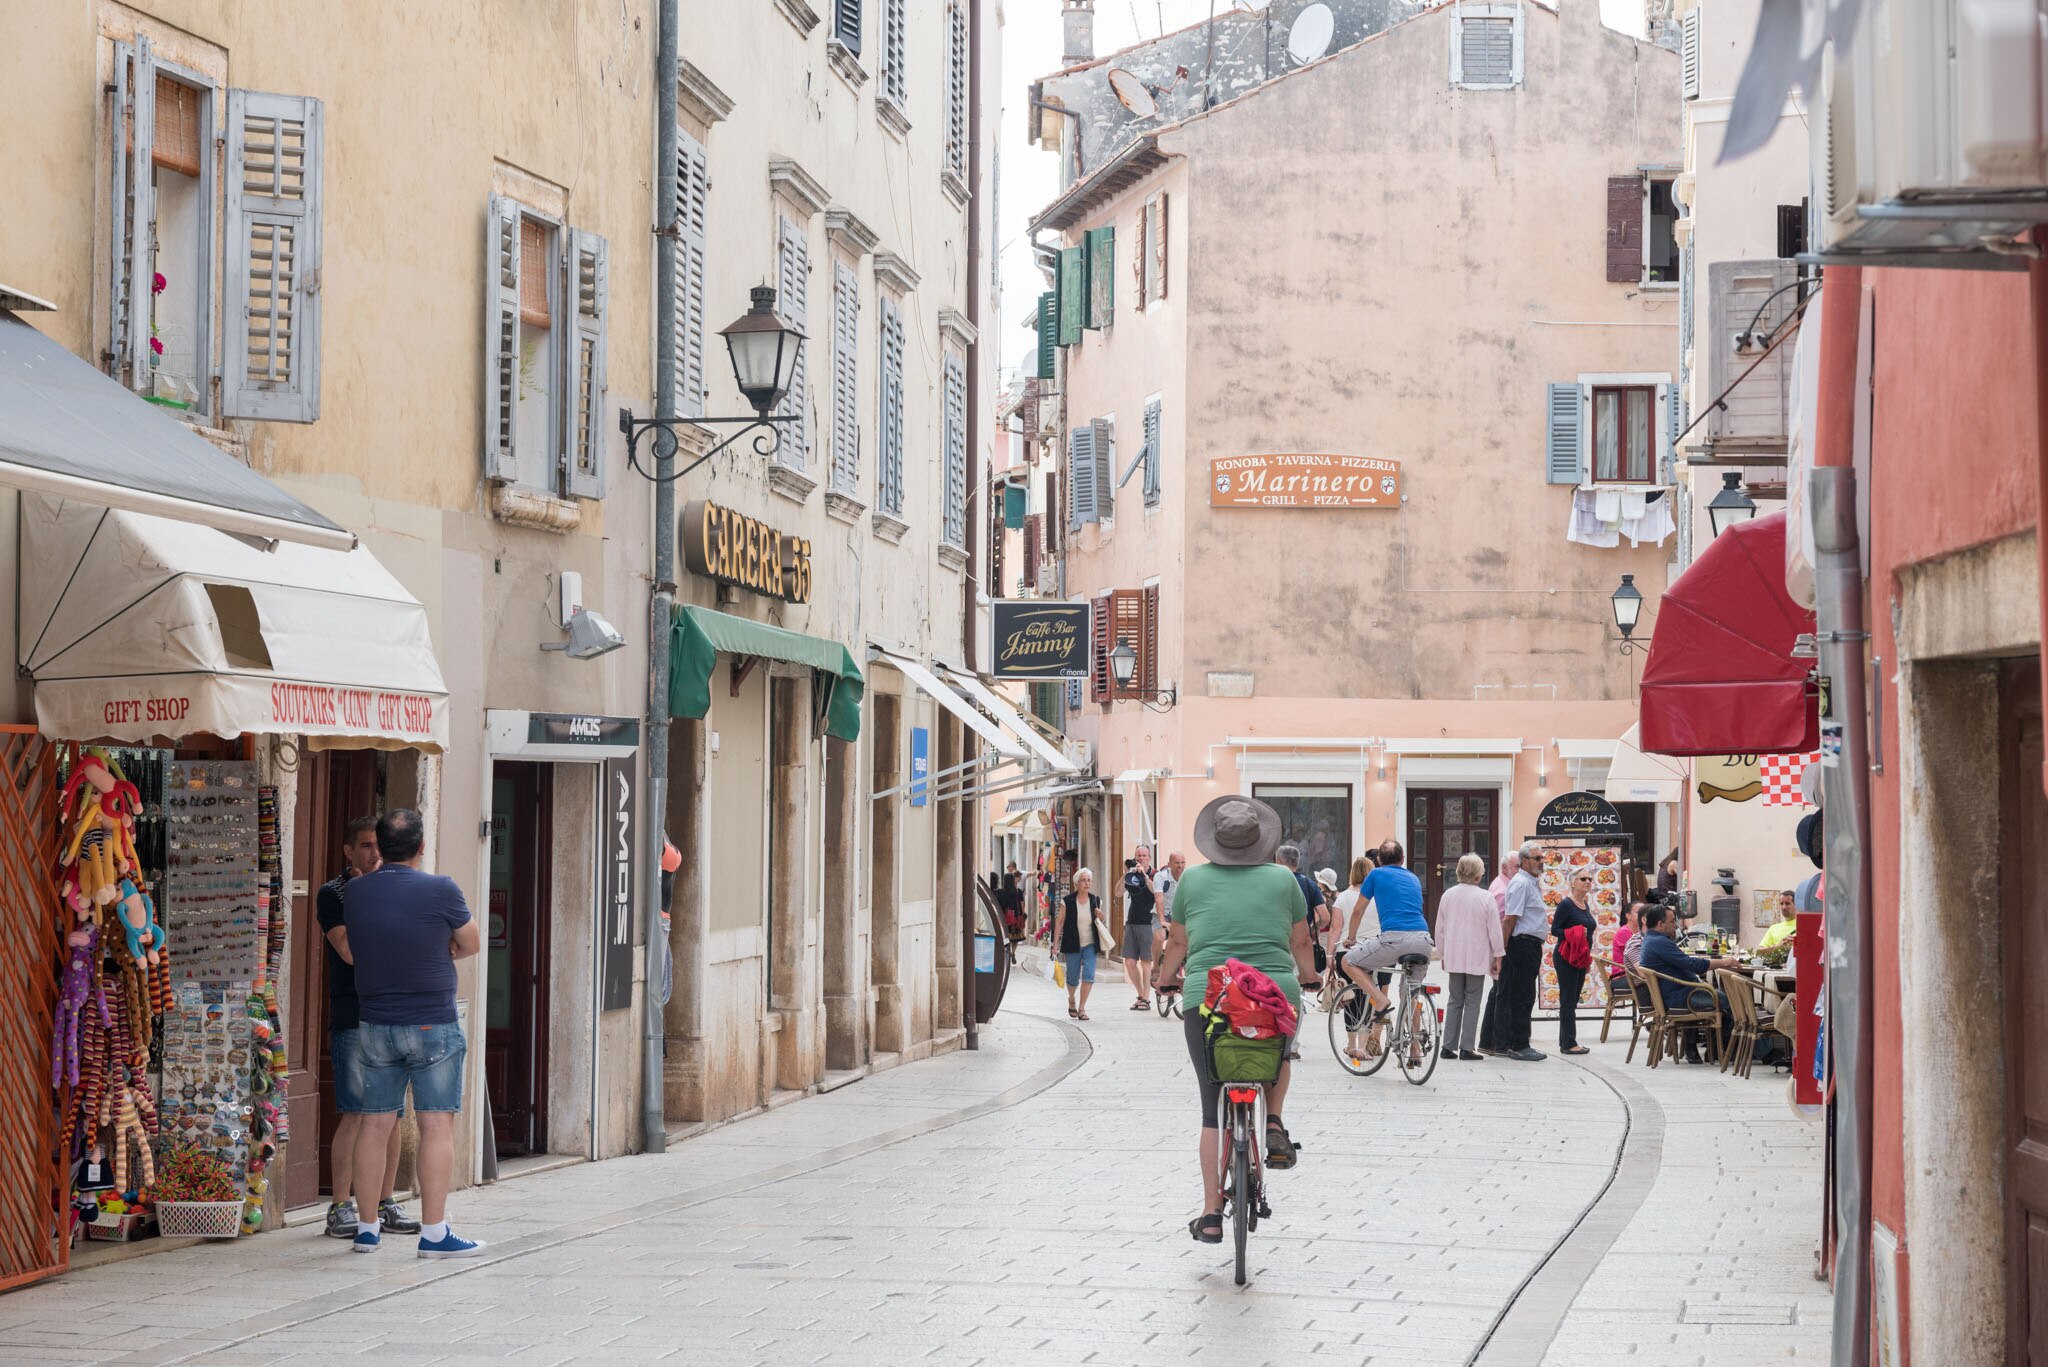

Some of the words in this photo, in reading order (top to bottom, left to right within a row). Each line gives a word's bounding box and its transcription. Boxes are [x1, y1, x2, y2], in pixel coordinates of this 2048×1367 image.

[1215, 457, 1267, 471] KONOBA
[1276, 455, 1332, 466] TAVERNA
[1341, 457, 1397, 472] PIZZERIA
[1237, 468, 1373, 493] Marinero
[1262, 495, 1298, 505] GRILL
[1313, 495, 1350, 505] PIZZA
[703, 499, 785, 598] CARERA
[792, 536, 811, 604] 55
[1025, 621, 1051, 638] Caffe
[1052, 619, 1077, 634] Bar
[1000, 630, 1077, 661] Jimmy
[104, 700, 141, 724] GIFT
[146, 697, 190, 722] SHOP
[271, 681, 336, 726] SOUVENIRS
[378, 692, 401, 731] GIFT
[404, 695, 432, 733] SHOP
[569, 717, 601, 737] AMOS
[1539, 813, 1580, 827] STEAK
[1581, 813, 1619, 825] HOUSE
[617, 770, 630, 945] AMOS
